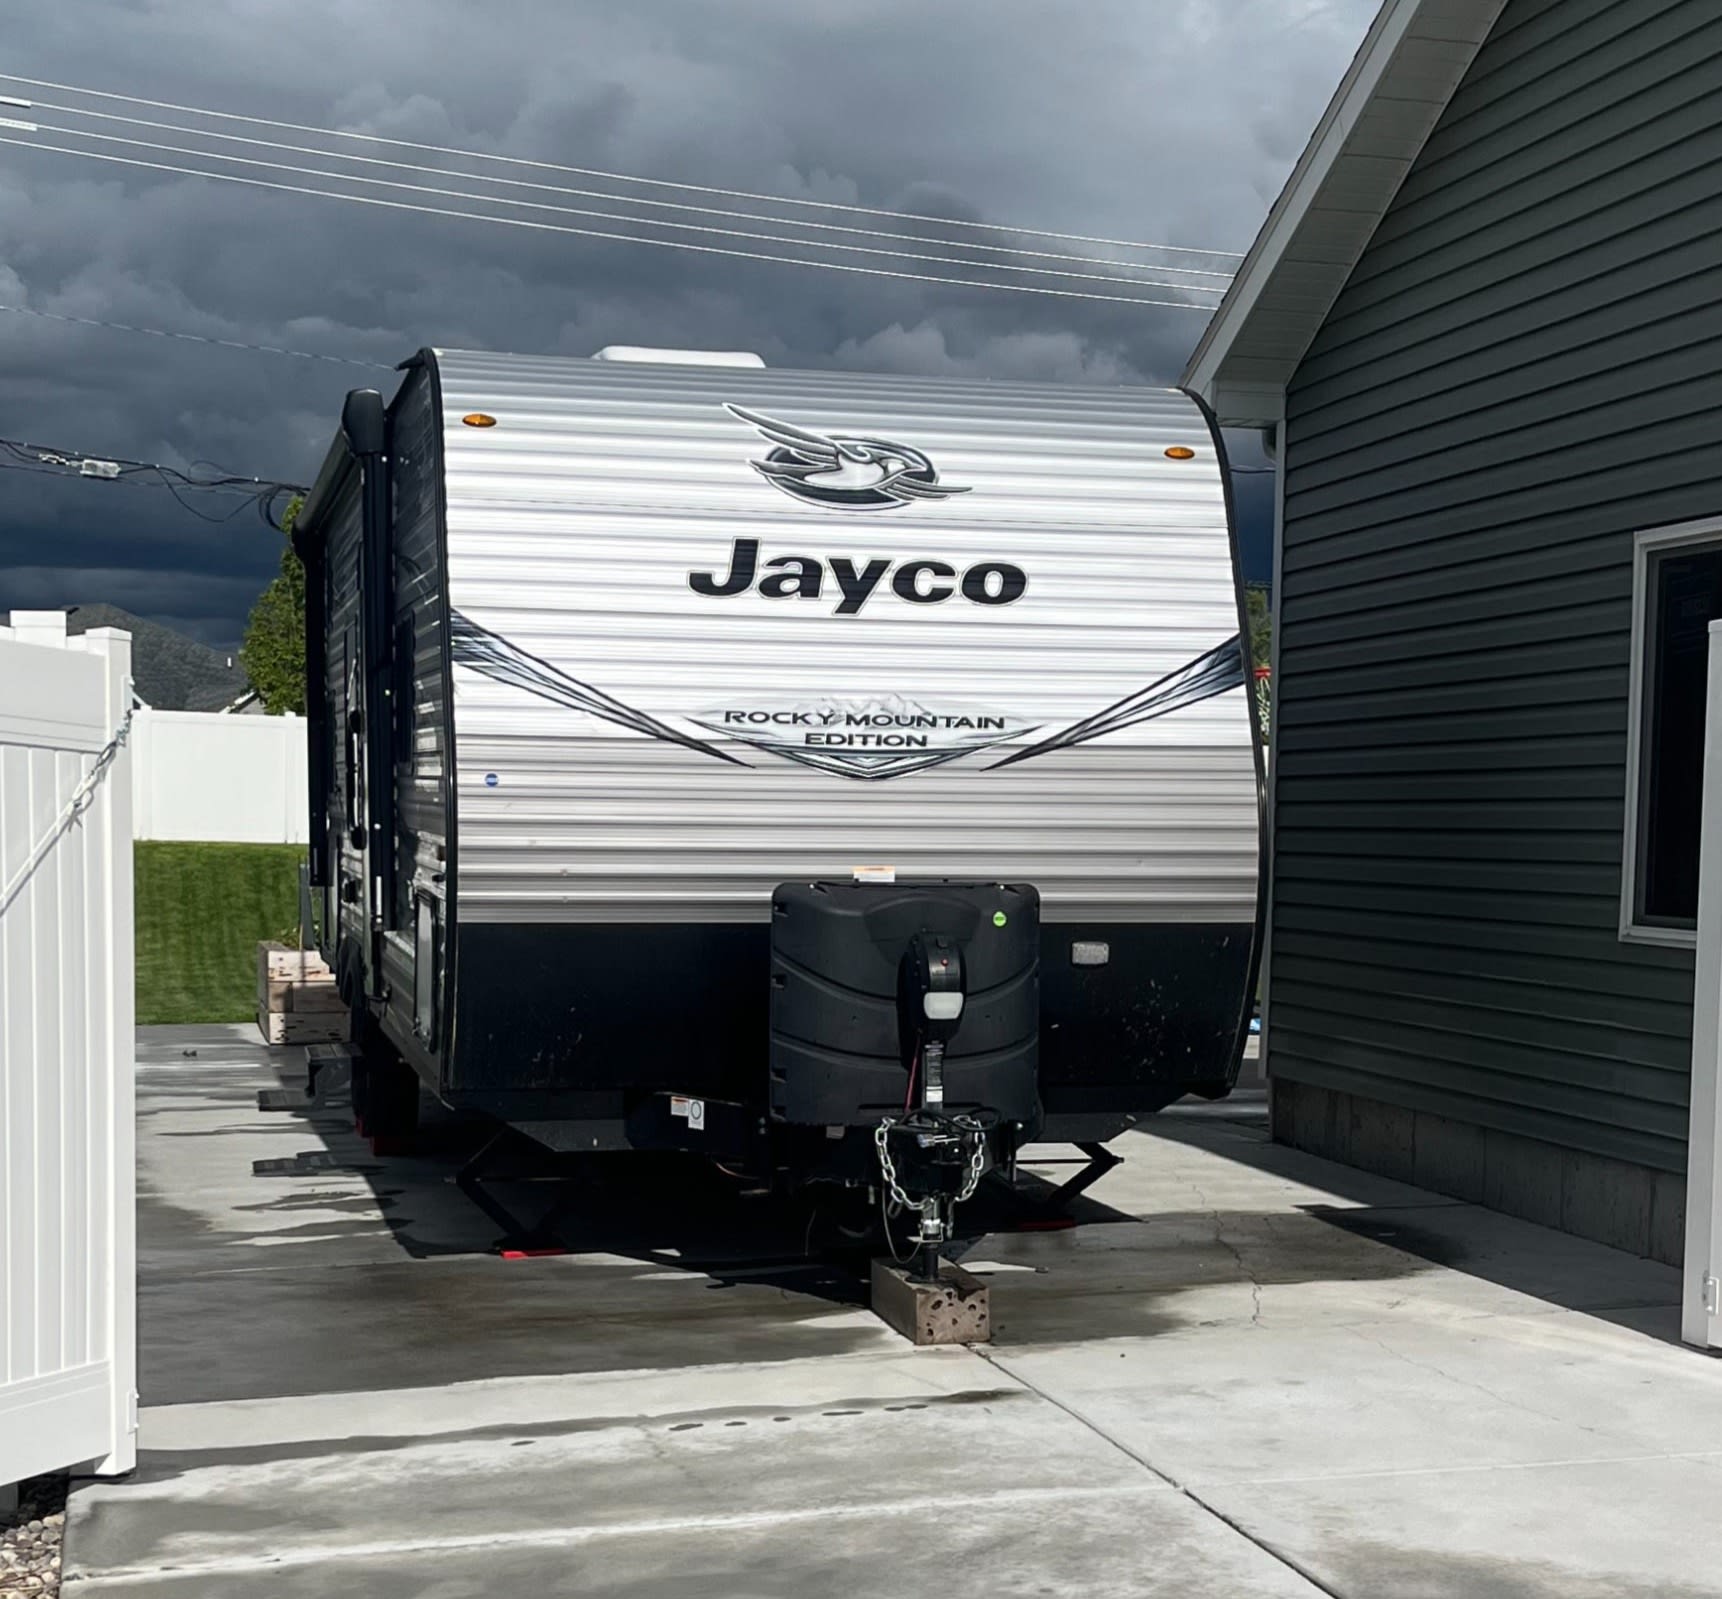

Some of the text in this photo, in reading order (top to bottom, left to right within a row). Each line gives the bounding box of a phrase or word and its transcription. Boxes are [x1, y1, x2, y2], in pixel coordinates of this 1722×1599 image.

[688, 537, 1028, 615] Jayco
[724, 710, 1005, 729] ROCKY MOUNTAIN
[804, 732, 928, 747] EDITION
